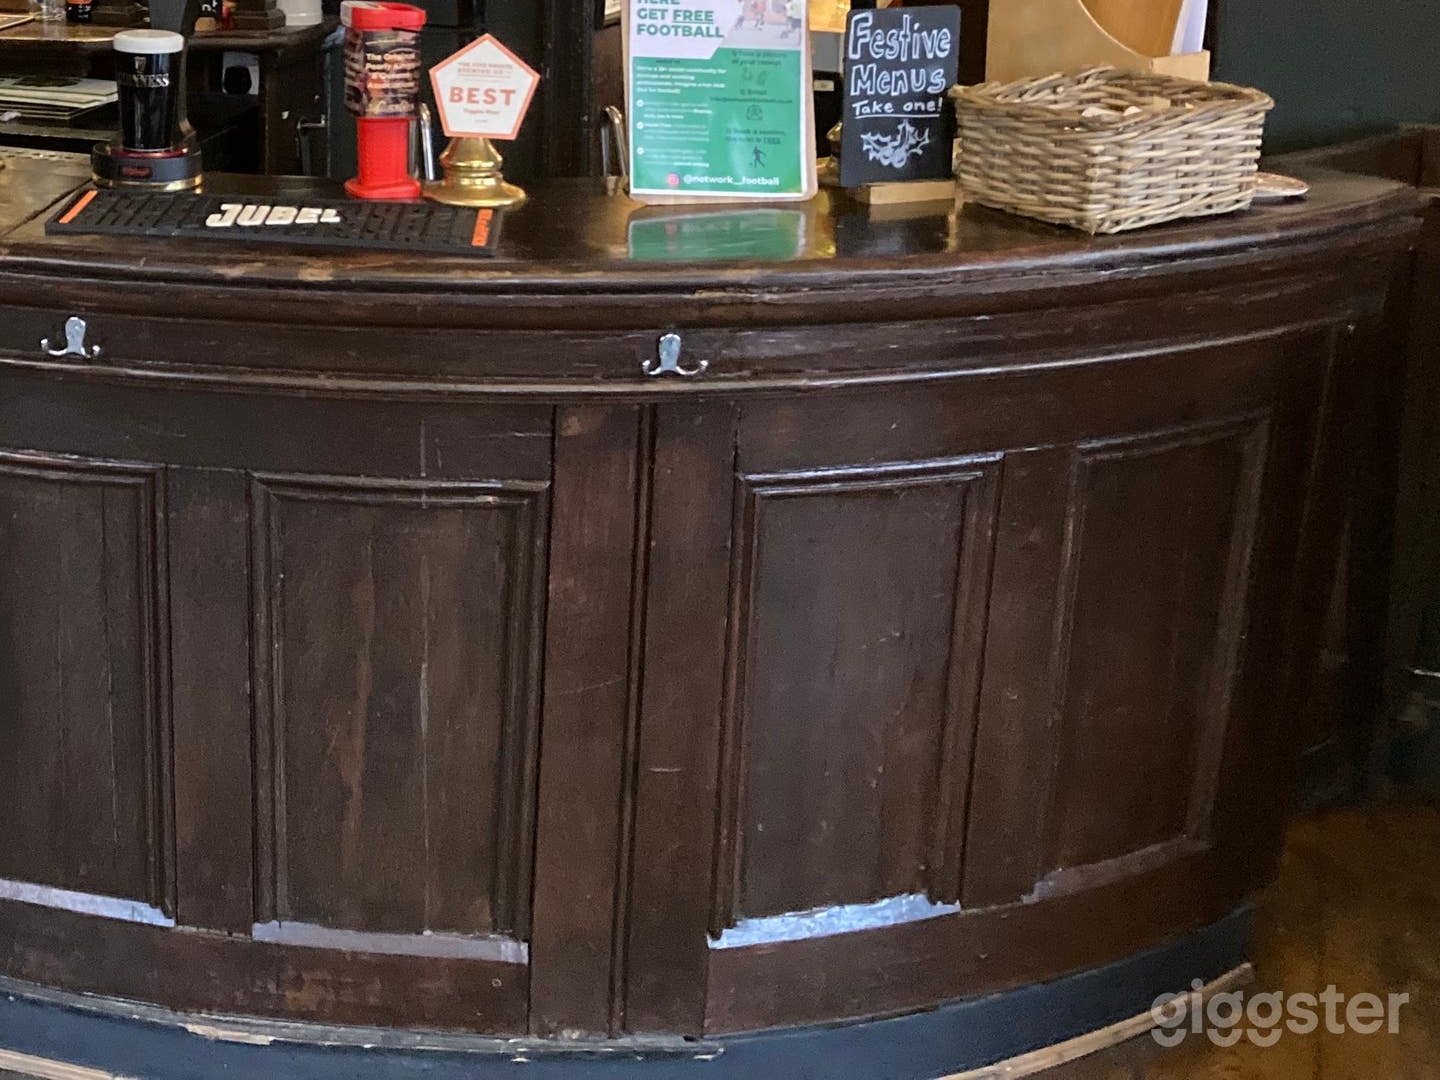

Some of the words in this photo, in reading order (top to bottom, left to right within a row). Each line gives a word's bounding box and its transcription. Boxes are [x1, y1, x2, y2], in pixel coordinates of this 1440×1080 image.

[636, 7, 669, 20] GET
[672, 9, 715, 21] FREE
[636, 23, 725, 39] FOOTBALL
[848, 11, 951, 62] Festive
[849, 63, 946, 97] Menus
[449, 86, 517, 106] BEST
[852, 99, 895, 116] Take
[902, 96, 944, 112] one!
[205, 203, 341, 227] JUBEL
